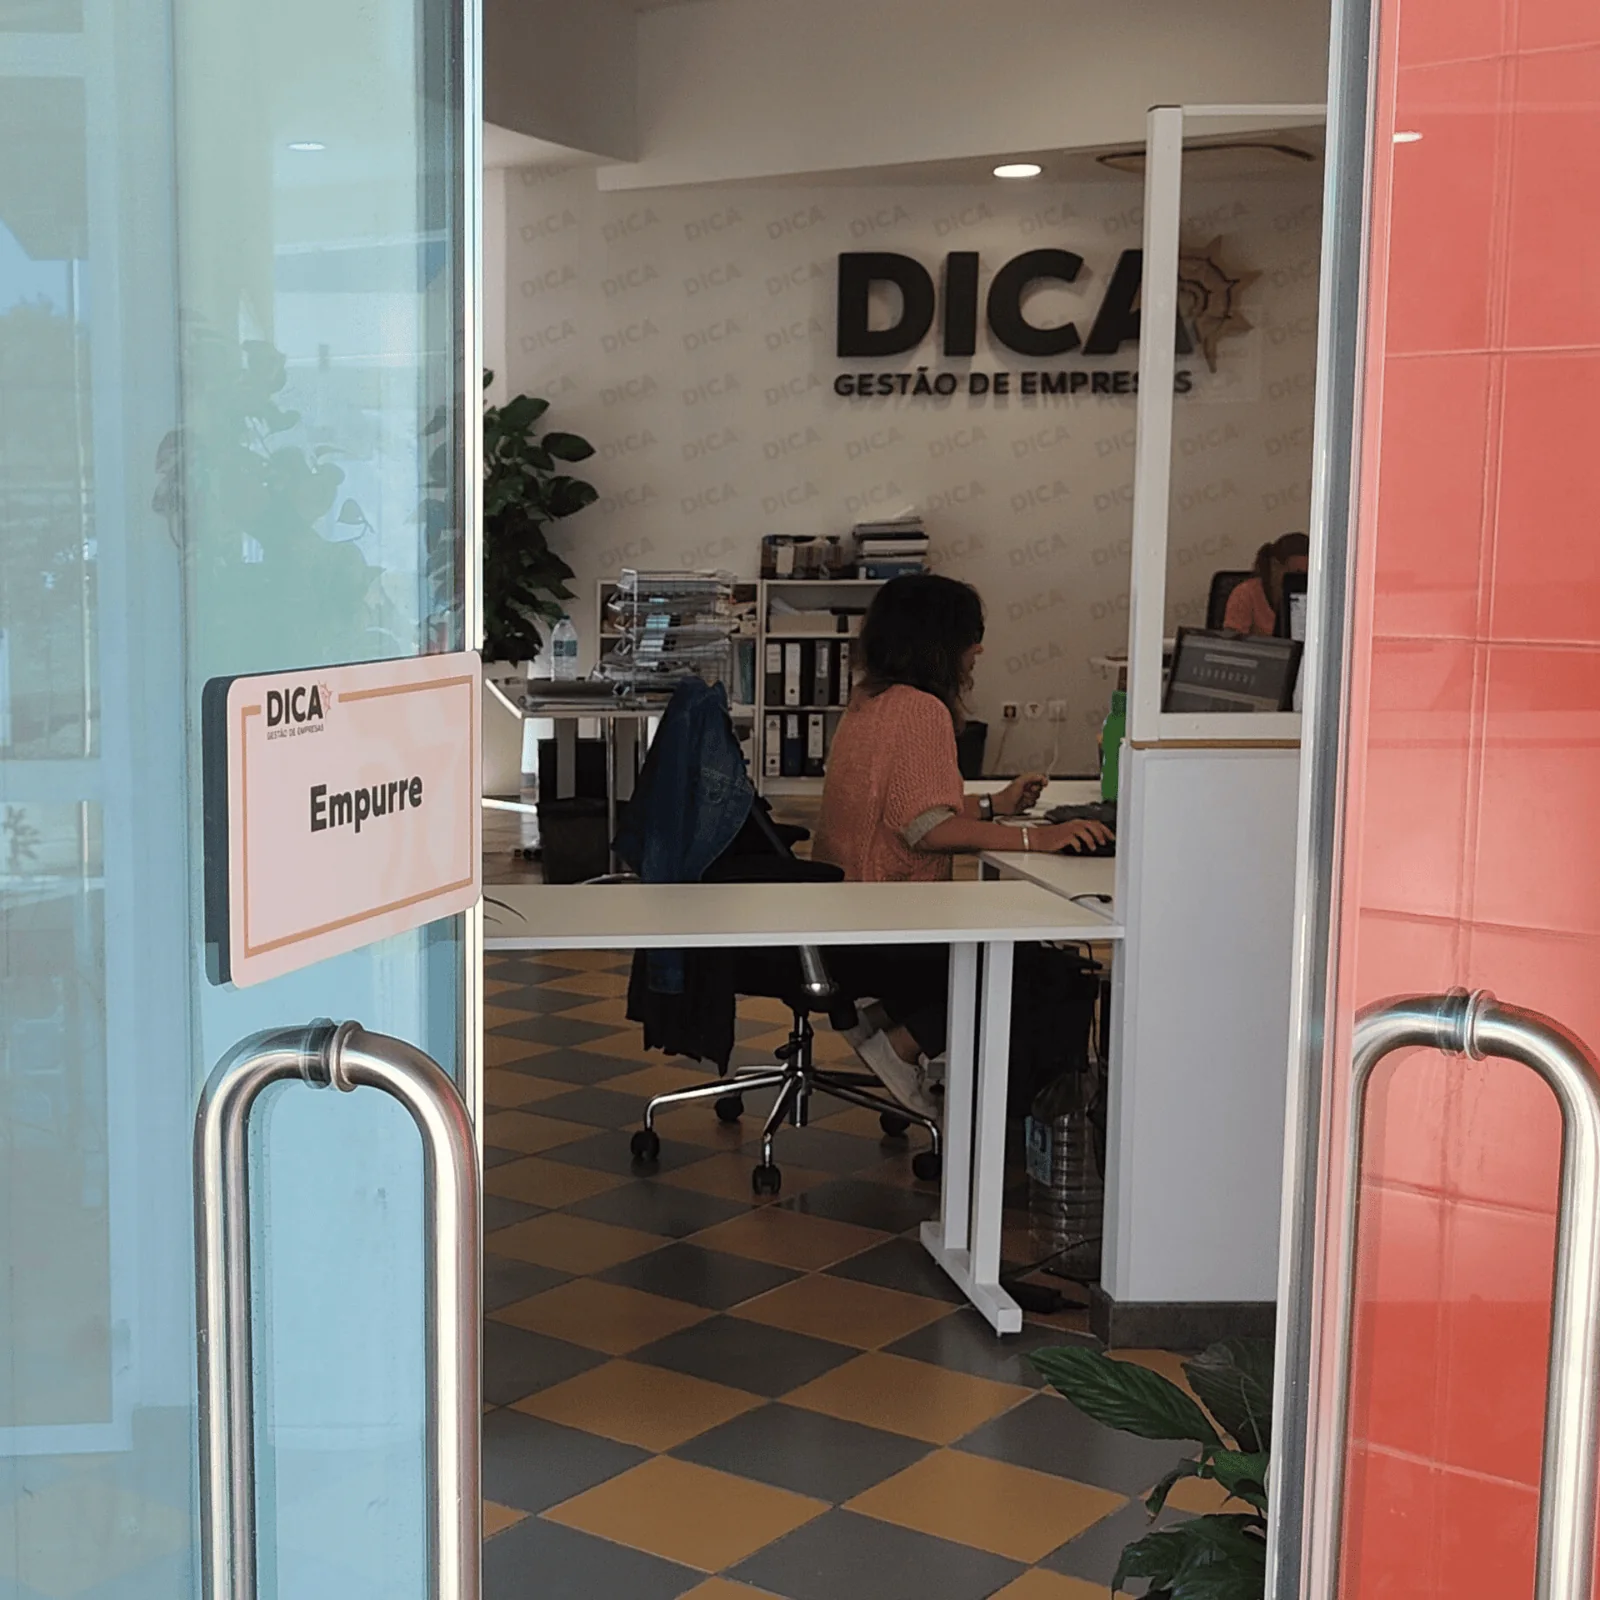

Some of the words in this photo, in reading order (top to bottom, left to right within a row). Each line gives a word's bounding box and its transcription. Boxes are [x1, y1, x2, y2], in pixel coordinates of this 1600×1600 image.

[519, 209, 577, 243] DICA
[601, 208, 660, 243] DICA
[683, 206, 743, 241] DICA
[766, 205, 827, 240] DICA
[849, 204, 912, 238] DICA
[932, 202, 994, 236] DICA
[1018, 202, 1078, 235] DICA
[1102, 206, 1142, 235] DIC
[520, 265, 578, 298] DICA
[601, 264, 660, 297] DICA
[683, 263, 743, 297] DICA
[765, 262, 825, 296] DICA
[837, 248, 1194, 357] DICA
[520, 319, 577, 353] DICA
[601, 318, 660, 353] DICA
[682, 318, 742, 351] DICA
[765, 317, 823, 350] DICA
[600, 374, 658, 406] DICA
[681, 373, 740, 406] DICA
[764, 373, 822, 406] DICA
[834, 366, 957, 396] GESTÃO
[968, 372, 1010, 395] DE
[1021, 370, 1193, 395] EMPRES
[602, 429, 658, 461] DICA
[681, 427, 739, 462] DICA
[762, 426, 822, 461] DICA
[844, 426, 904, 461] DICA
[928, 425, 987, 459] DICA
[1011, 425, 1071, 459] DICA
[1094, 429, 1136, 458] DIC
[1179, 423, 1239, 456] DICA
[1265, 424, 1313, 457] DIC
[601, 483, 658, 514] DICA
[680, 482, 738, 515] DICA
[761, 481, 819, 515] DICA
[844, 480, 901, 514] DICA
[926, 479, 986, 513] DICA
[1010, 480, 1071, 513] DICA
[1093, 484, 1134, 513] DIC
[1178, 478, 1239, 512] DICA
[1261, 479, 1311, 513] DIC
[601, 537, 655, 567] DICA
[680, 536, 735, 566] DICA
[927, 533, 984, 566] DICA
[1009, 532, 1067, 567] DICA
[1091, 537, 1131, 566] DIC
[1006, 588, 1066, 622] DICA
[1090, 593, 1129, 620] DIC
[1004, 641, 1066, 675] DICA
[267, 685, 323, 727] DICA
[310, 776, 423, 833] Empurre
